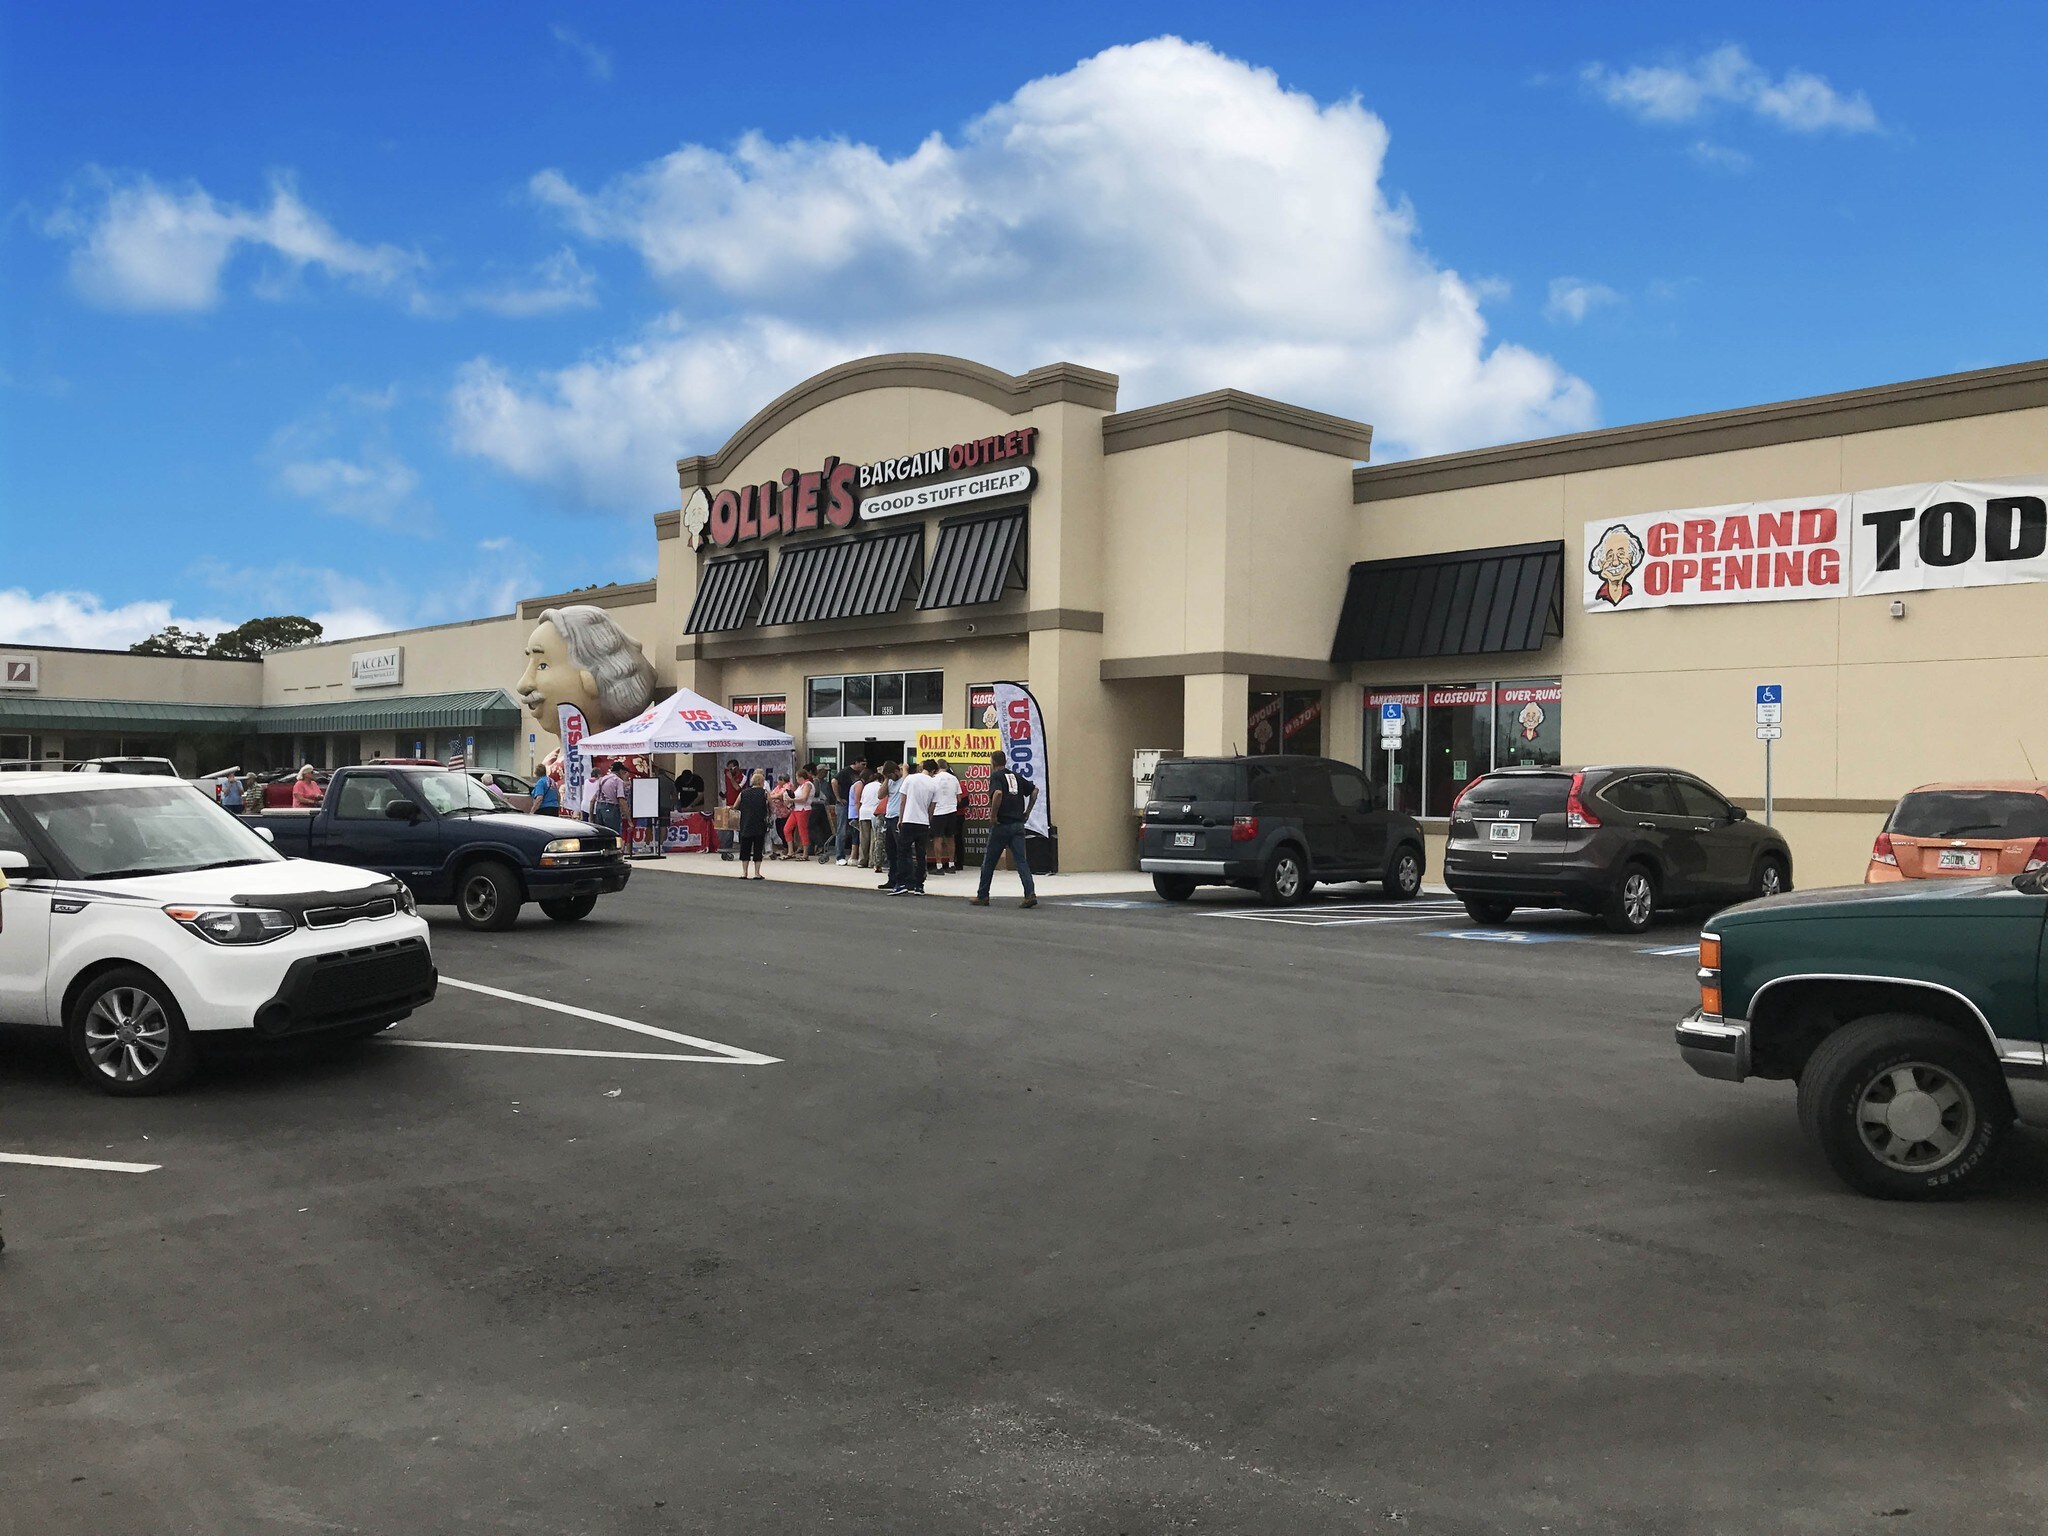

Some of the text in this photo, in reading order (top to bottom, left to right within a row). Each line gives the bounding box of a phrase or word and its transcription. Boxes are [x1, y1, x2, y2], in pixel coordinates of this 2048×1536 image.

[860, 428, 1036, 488] BARGAIN OUTLET
[918, 484, 967, 505] STUFF
[1647, 508, 1837, 557] GRAND
[1644, 548, 1840, 596] OPENING
[360, 654, 396, 670] ACCENT
[1370, 694, 1419, 705] BANKRUPTCIES
[1434, 690, 1487, 704] CLOSEOUTS
[1505, 688, 1562, 702] OVER-RUNS
[679, 710, 712, 721] US
[920, 733, 997, 750] OLLIE'S ARMY
[965, 765, 991, 779] JOIN
[968, 793, 989, 806] AND
